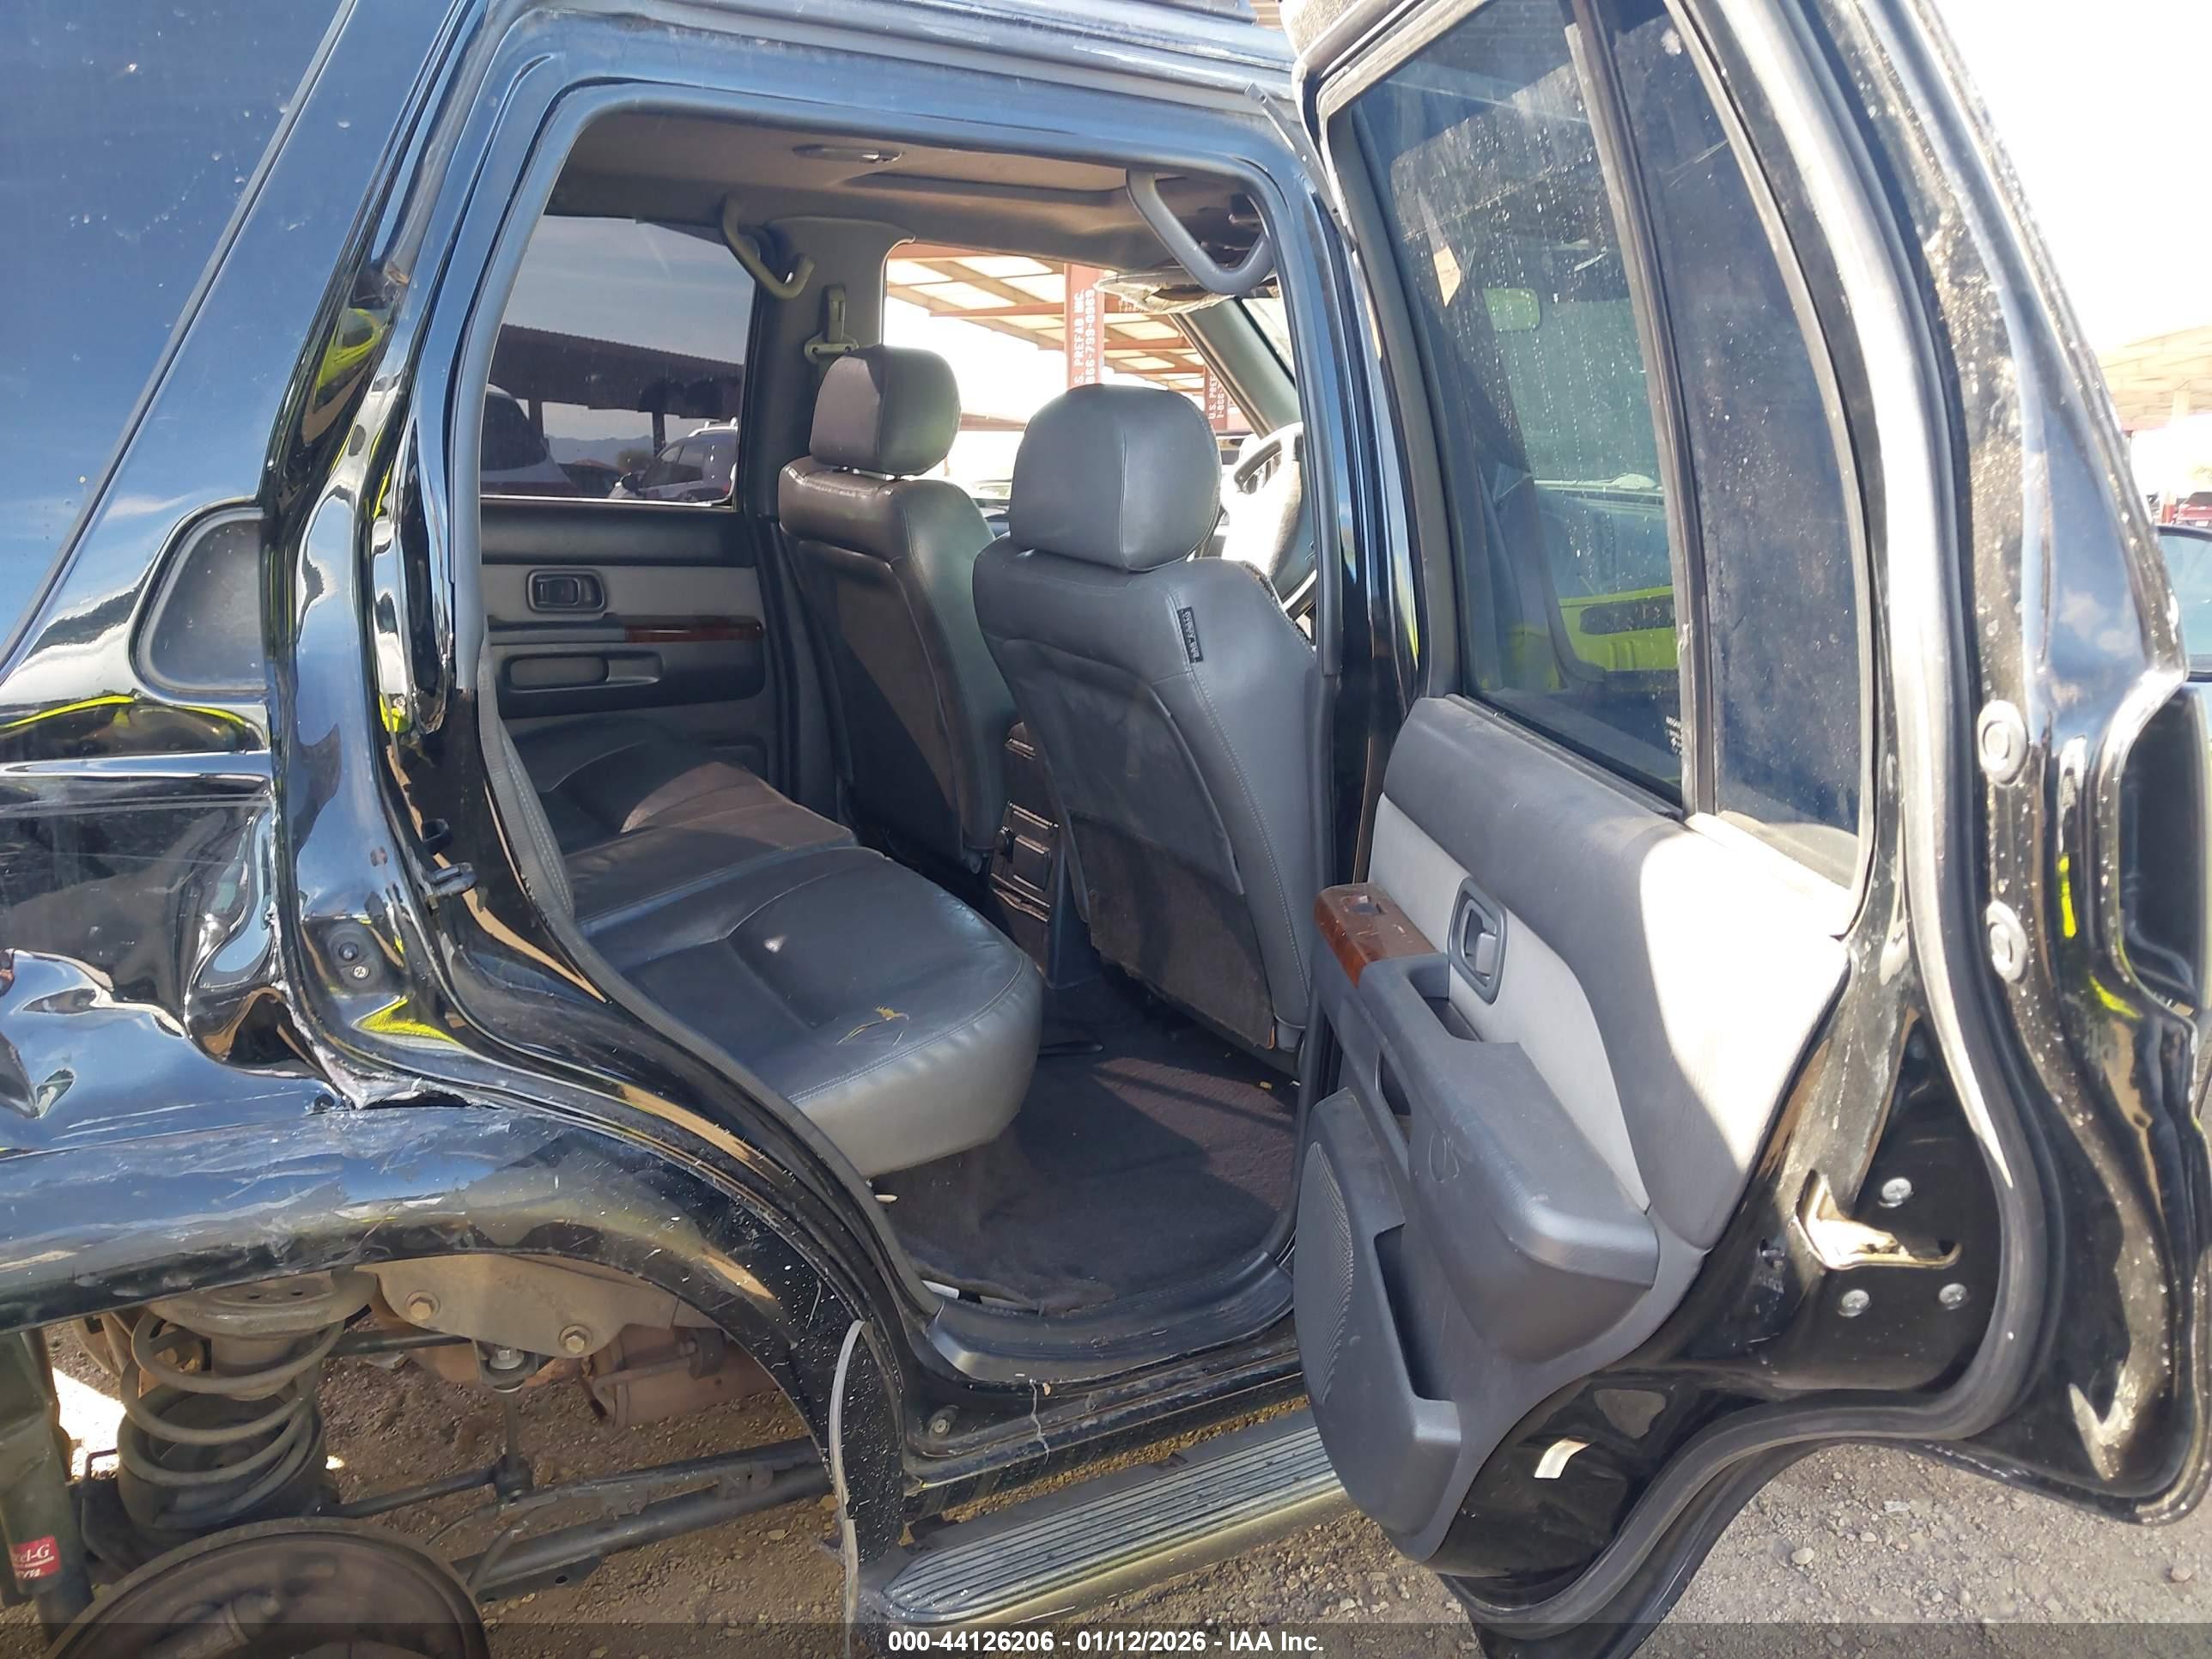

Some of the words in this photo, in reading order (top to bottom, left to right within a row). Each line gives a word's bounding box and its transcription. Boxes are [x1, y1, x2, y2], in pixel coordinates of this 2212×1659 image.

[1073, 289, 1085, 314] INC.
[1073, 318, 1085, 367] PREFAB
[1207, 402, 1217, 420] U.S.
